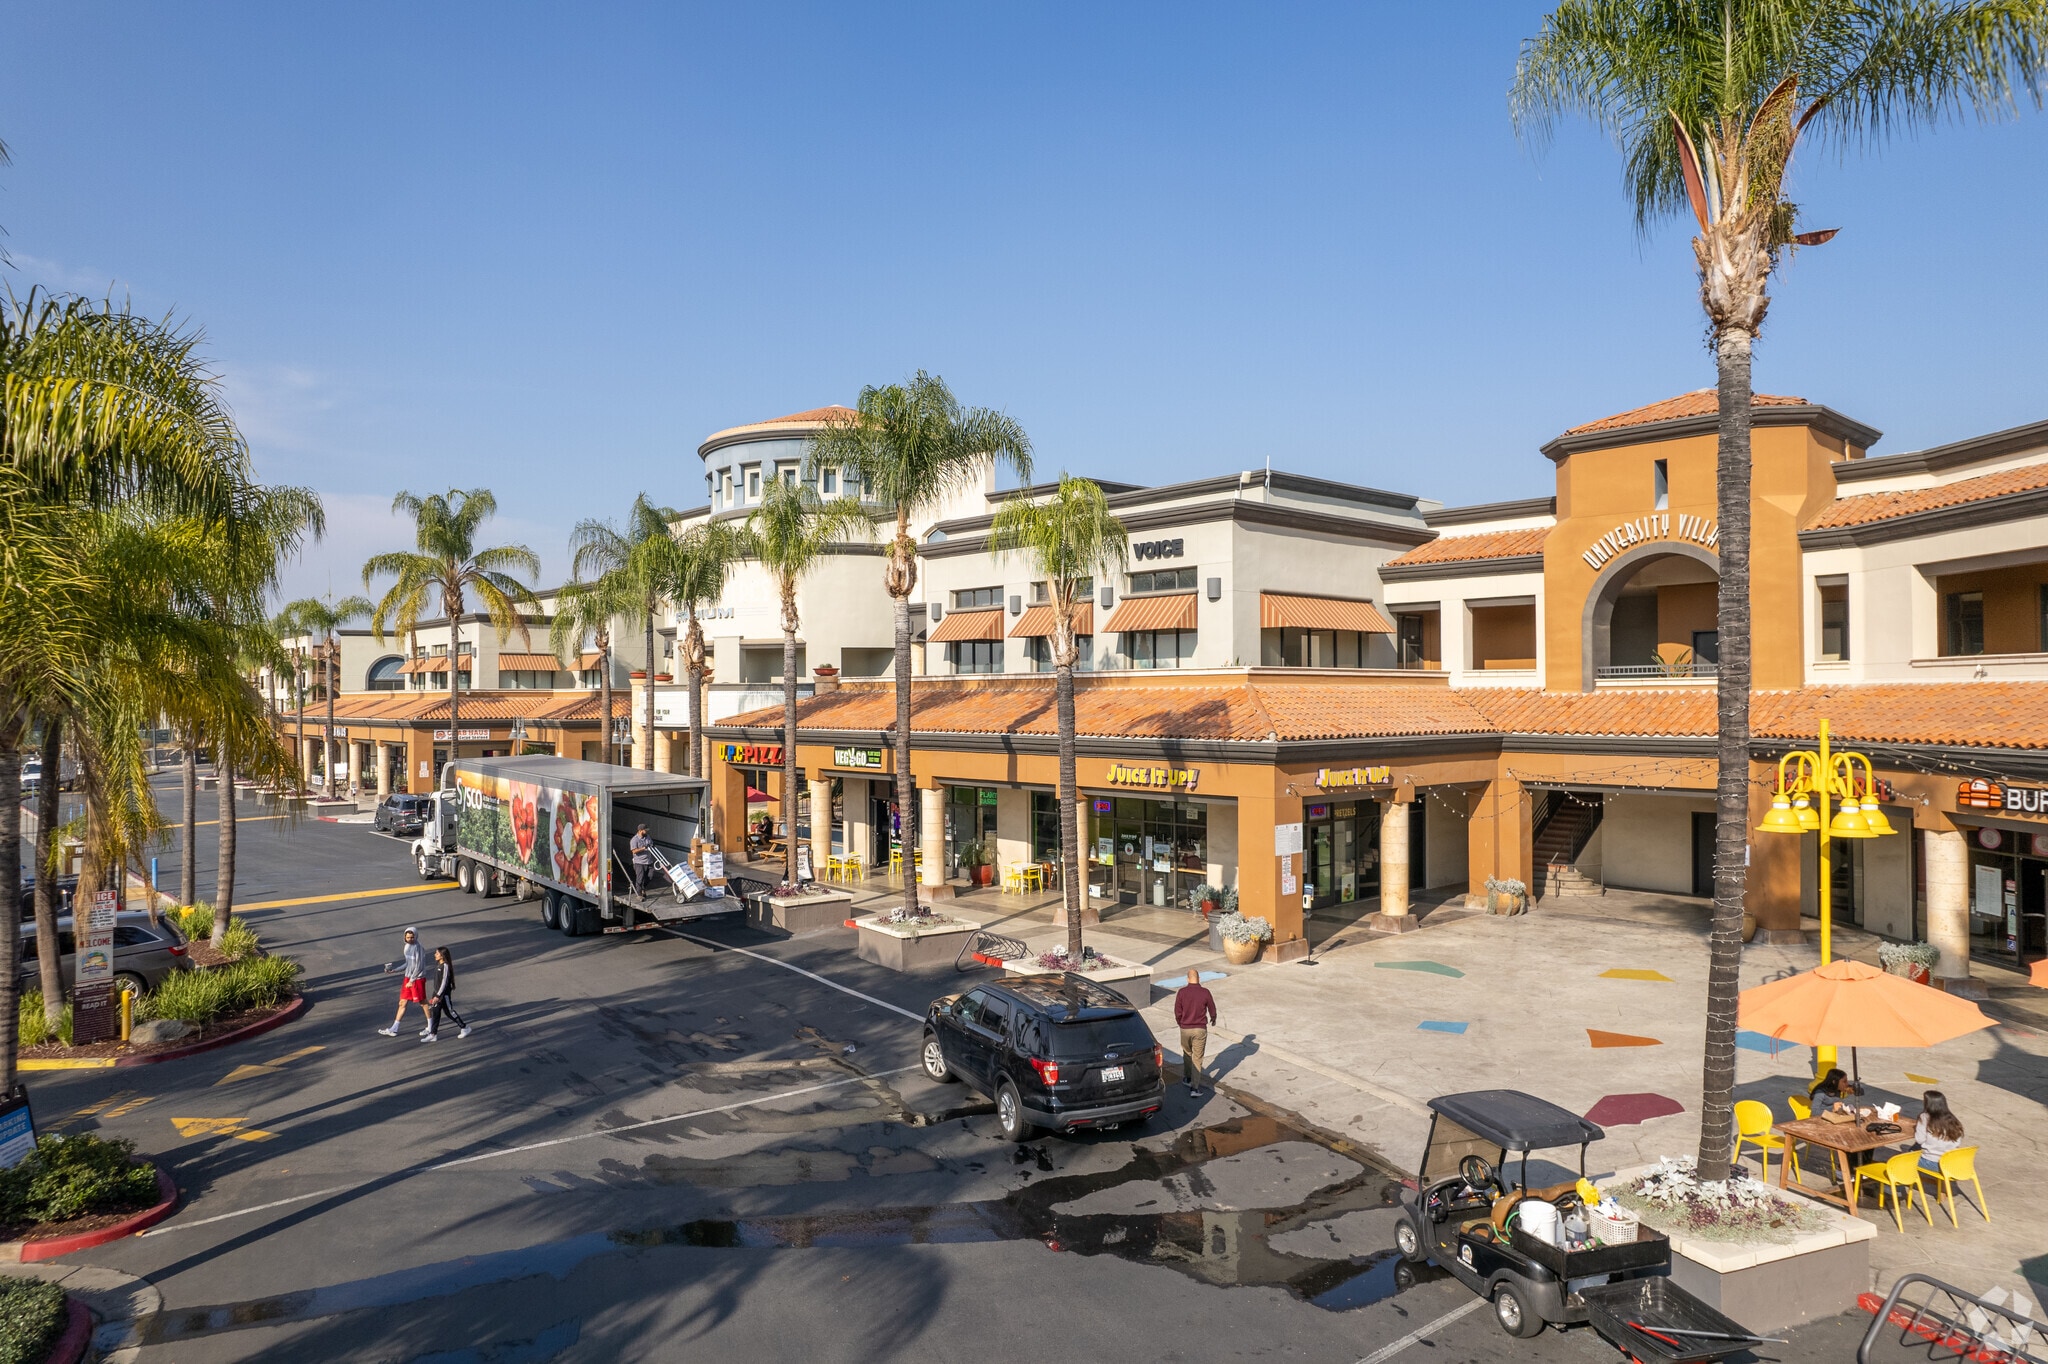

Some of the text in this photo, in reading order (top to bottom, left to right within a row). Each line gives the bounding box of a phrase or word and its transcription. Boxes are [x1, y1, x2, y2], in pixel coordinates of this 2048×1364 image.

[1133, 538, 1184, 561] VOICE
[1582, 514, 1670, 570] UNIVERSITY
[1106, 764, 1199, 790] JUICE IT UP!
[1318, 767, 1354, 787] JUICE
[1354, 767, 1368, 785] IT
[980, 791, 997, 799] PLANT
[81, 1001, 100, 1010] READ
